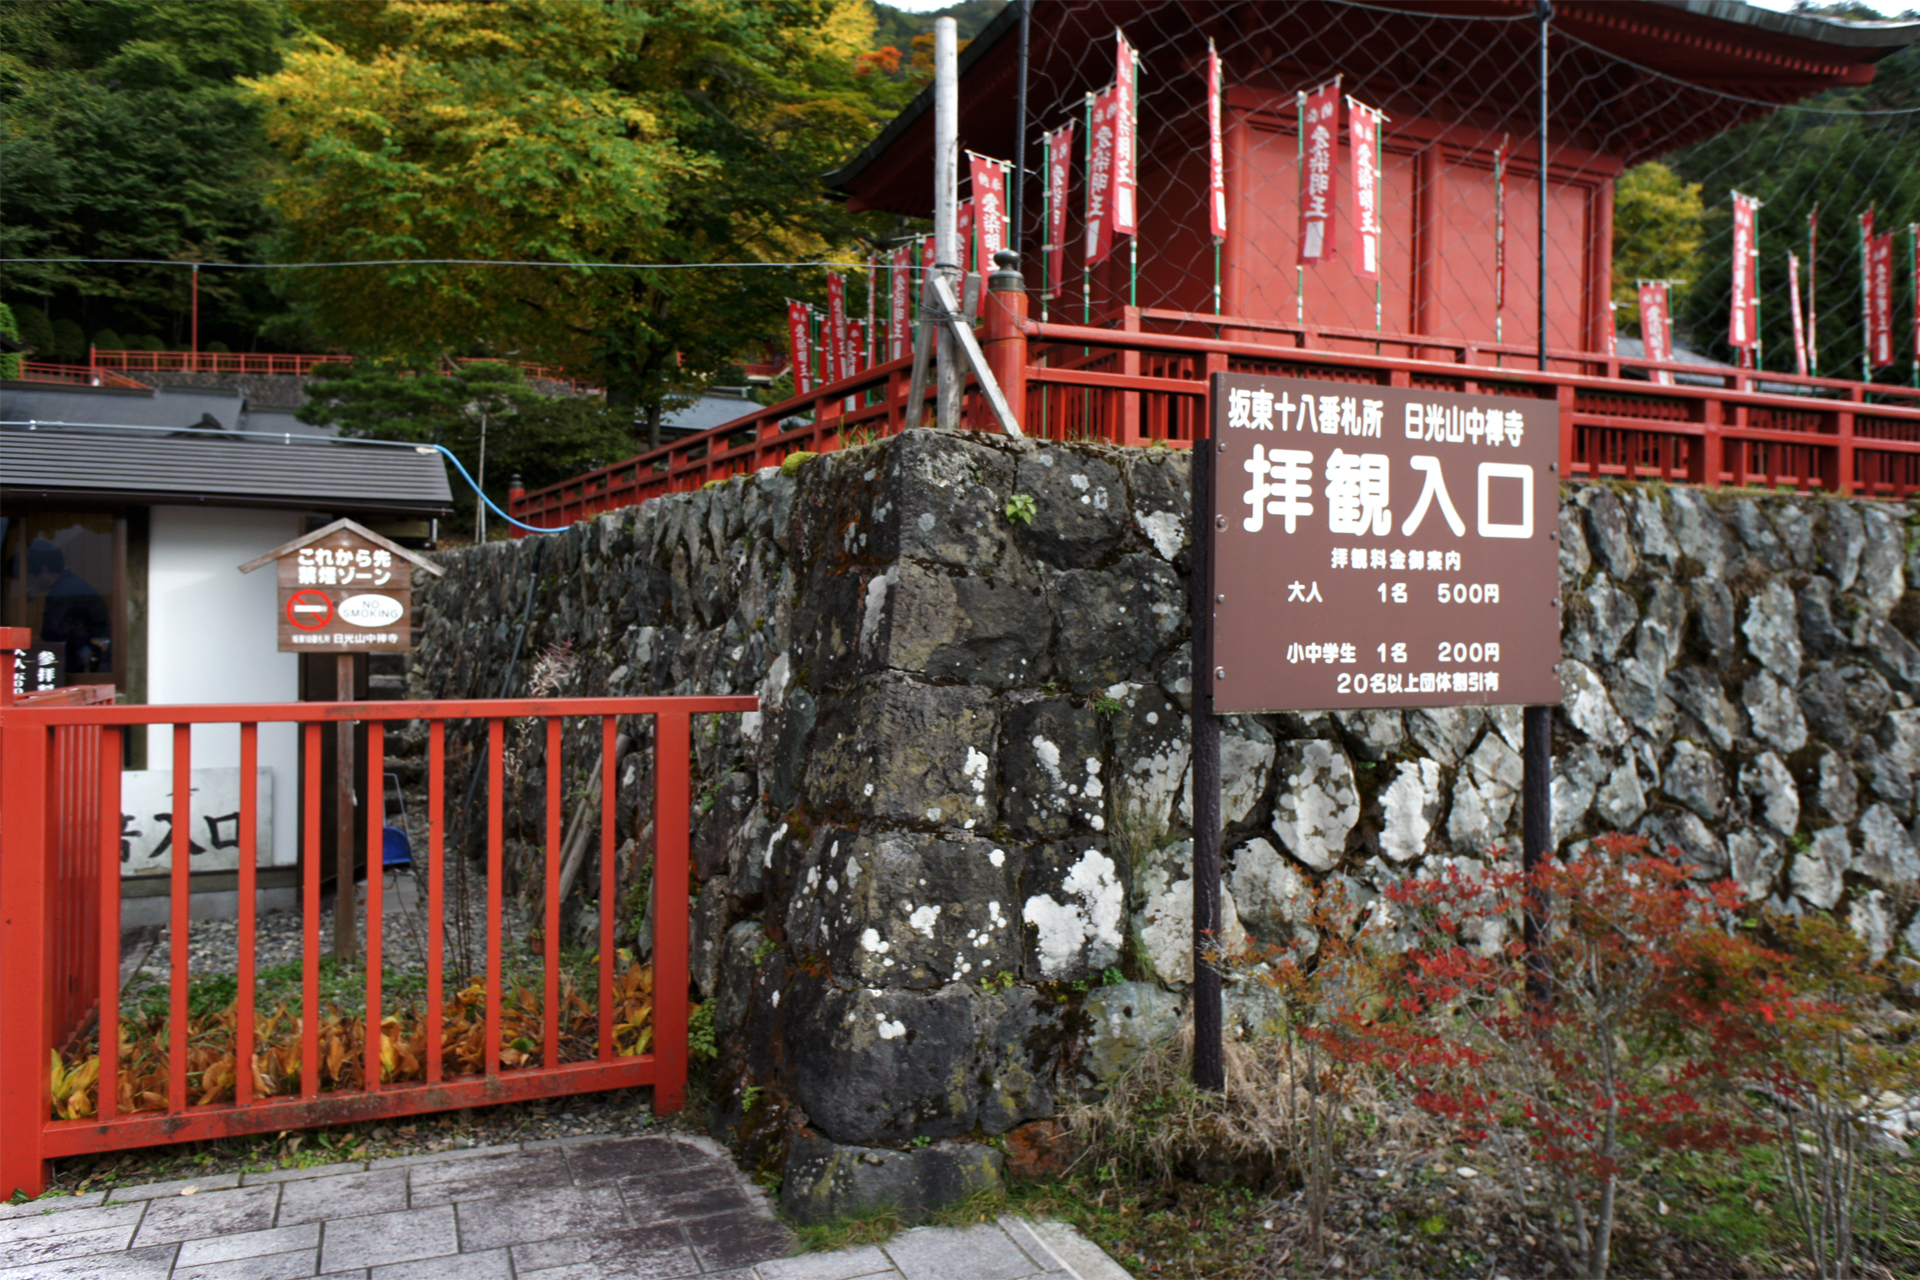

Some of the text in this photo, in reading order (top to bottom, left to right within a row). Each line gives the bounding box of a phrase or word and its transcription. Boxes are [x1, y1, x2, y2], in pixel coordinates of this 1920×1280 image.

[1227, 387, 1385, 439] 坂東十八番札所
[1242, 443, 1535, 539] 拝観入口
[297, 548, 392, 568] これから先
[1330, 547, 1462, 572] 拝観料金御案内
[298, 566, 392, 586] 禁煙ゾーン
[1287, 580, 1500, 604] 大人 1名 500円
[343, 608, 399, 619] SMOKING
[362, 600, 380, 610] NO
[1286, 642, 1501, 664] 小中学生 1名 200円
[1336, 671, 1500, 694] 20名以上団体割引有
